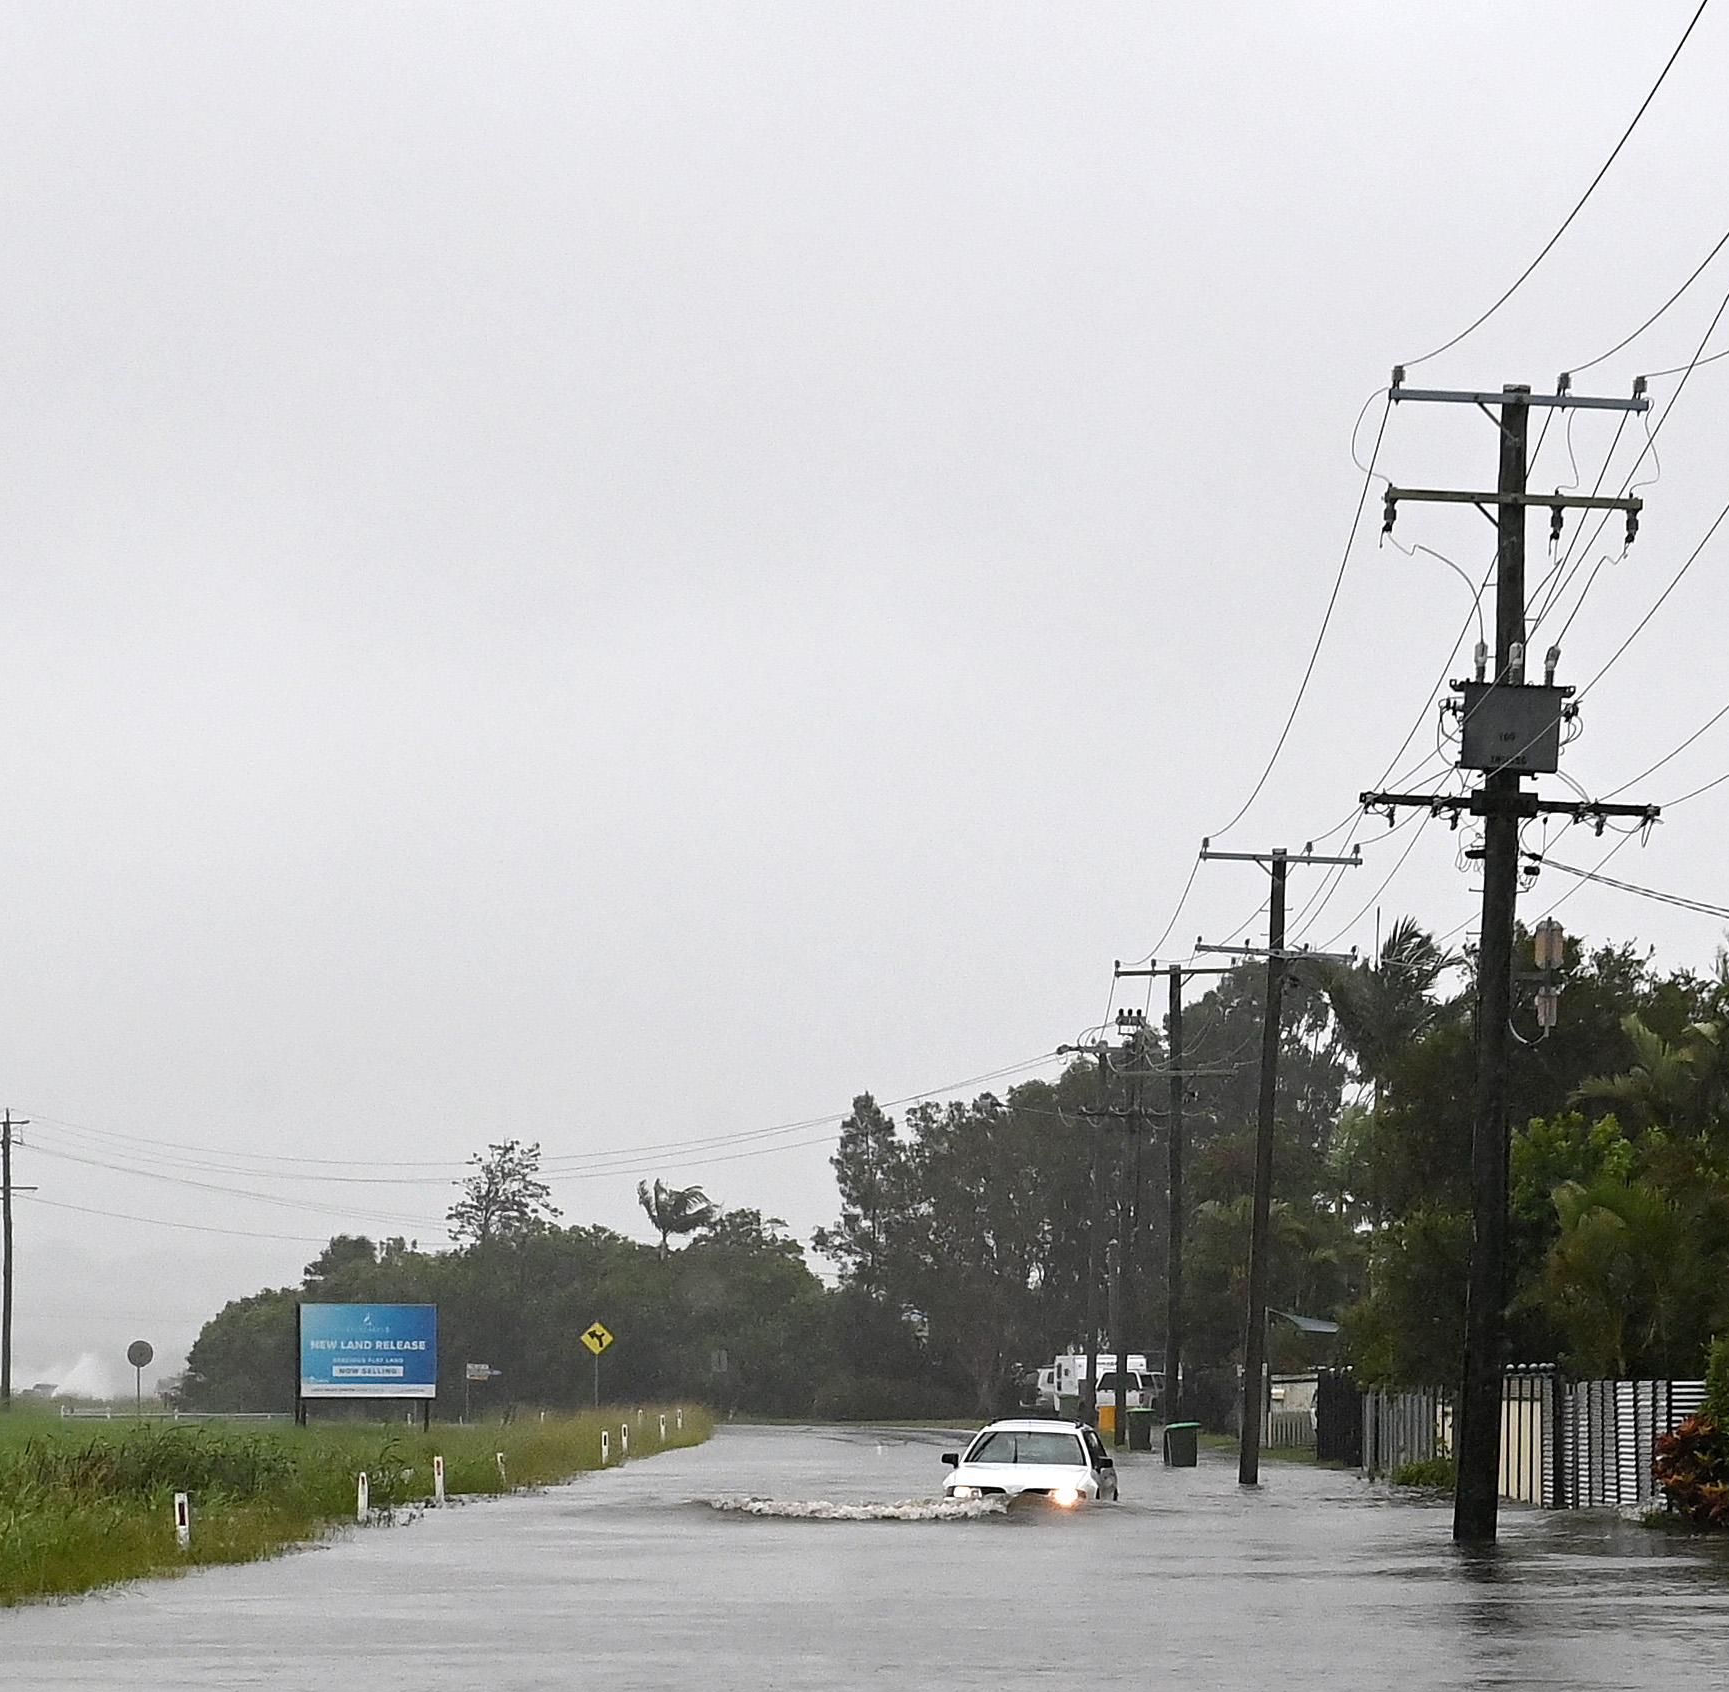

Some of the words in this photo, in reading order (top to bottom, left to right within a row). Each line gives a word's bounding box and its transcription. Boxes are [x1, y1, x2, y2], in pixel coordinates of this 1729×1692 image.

[310, 1340, 338, 1350] NEW
[340, 1340, 372, 1350] LAND
[375, 1340, 426, 1350] RELEASE
